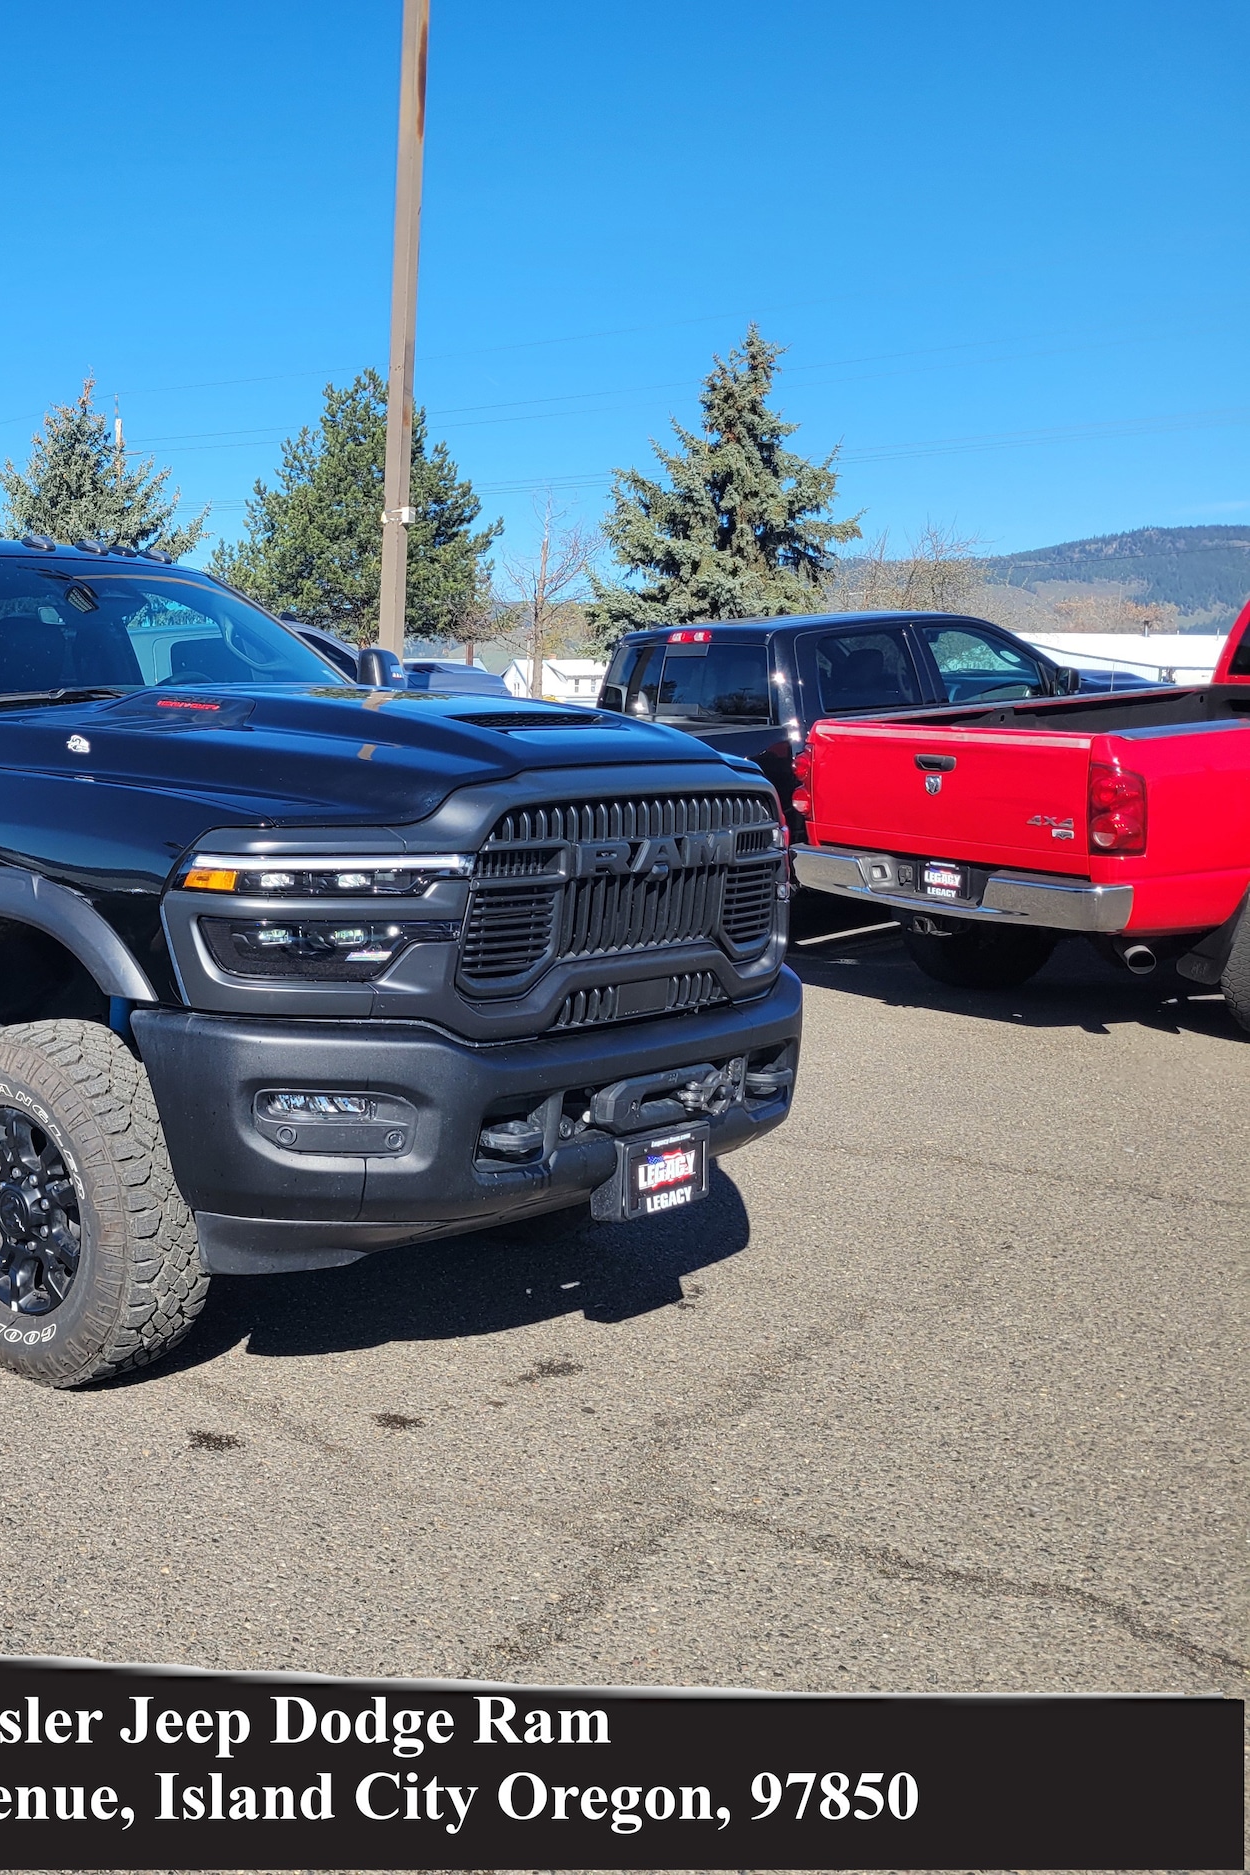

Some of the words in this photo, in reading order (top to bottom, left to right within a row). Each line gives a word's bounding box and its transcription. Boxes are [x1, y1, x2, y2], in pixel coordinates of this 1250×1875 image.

[576, 830, 730, 878] RAM
[924, 870, 961, 887] LEGACY
[927, 887, 956, 898] LEGACY
[638, 1152, 695, 1189] LEGACY
[646, 1186, 692, 1213] LEGACY
